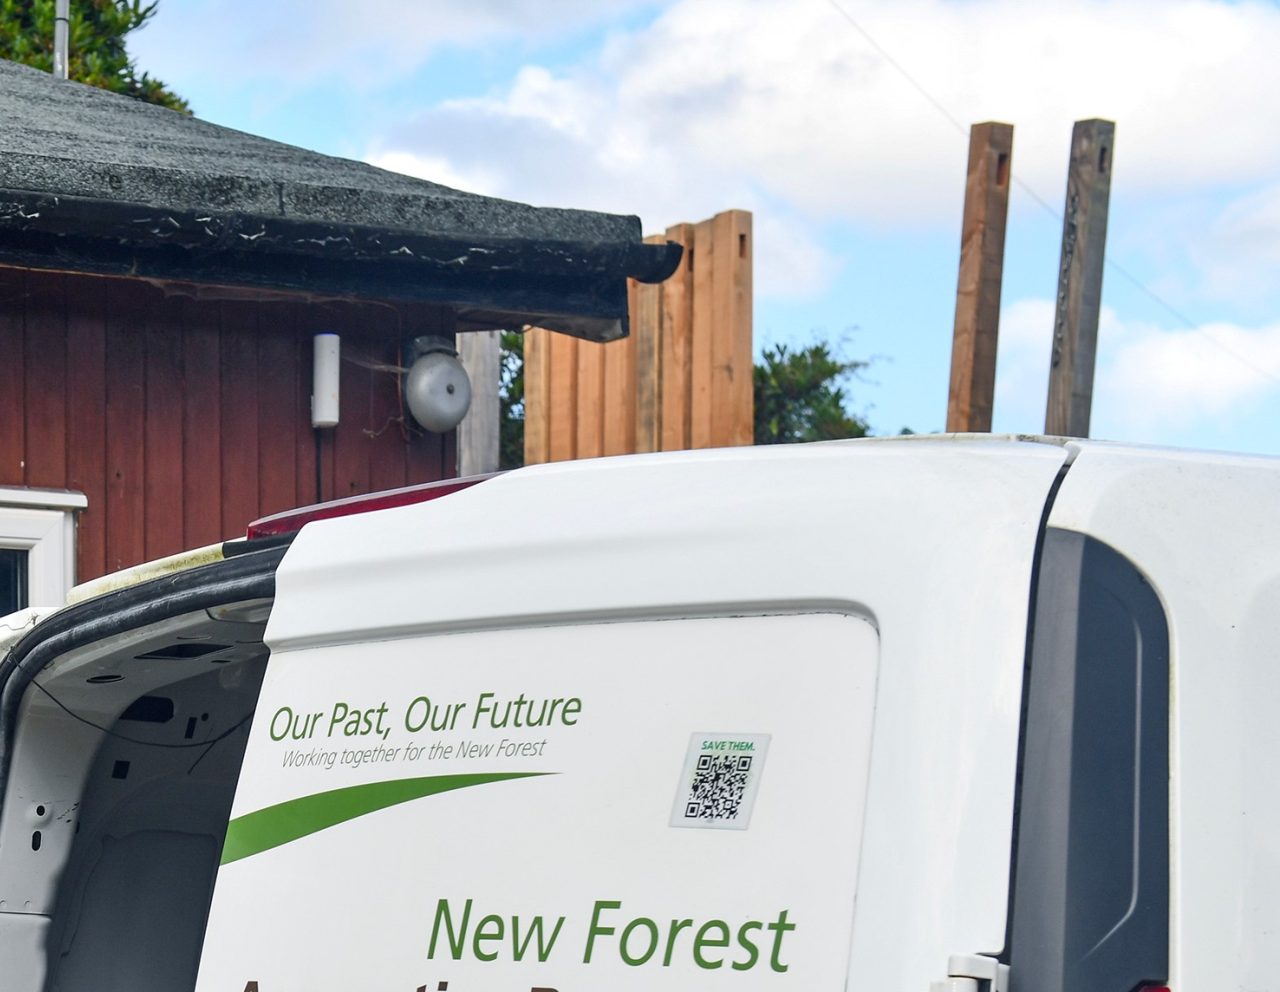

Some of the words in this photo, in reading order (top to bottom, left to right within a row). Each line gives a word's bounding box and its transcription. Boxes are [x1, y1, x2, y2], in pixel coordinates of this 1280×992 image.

[270, 706, 324, 742] Our
[327, 701, 392, 741] Past,
[405, 696, 467, 733] Our
[472, 692, 583, 730] Future
[282, 748, 338, 770] Working
[340, 744, 402, 769] together
[403, 741, 426, 761] for
[428, 740, 454, 761] the
[455, 740, 495, 759] New
[496, 738, 548, 758] Forest
[701, 740, 728, 751] SAVE
[729, 740, 756, 752] THEM.
[426, 898, 566, 963] New
[583, 899, 796, 974] Forest
